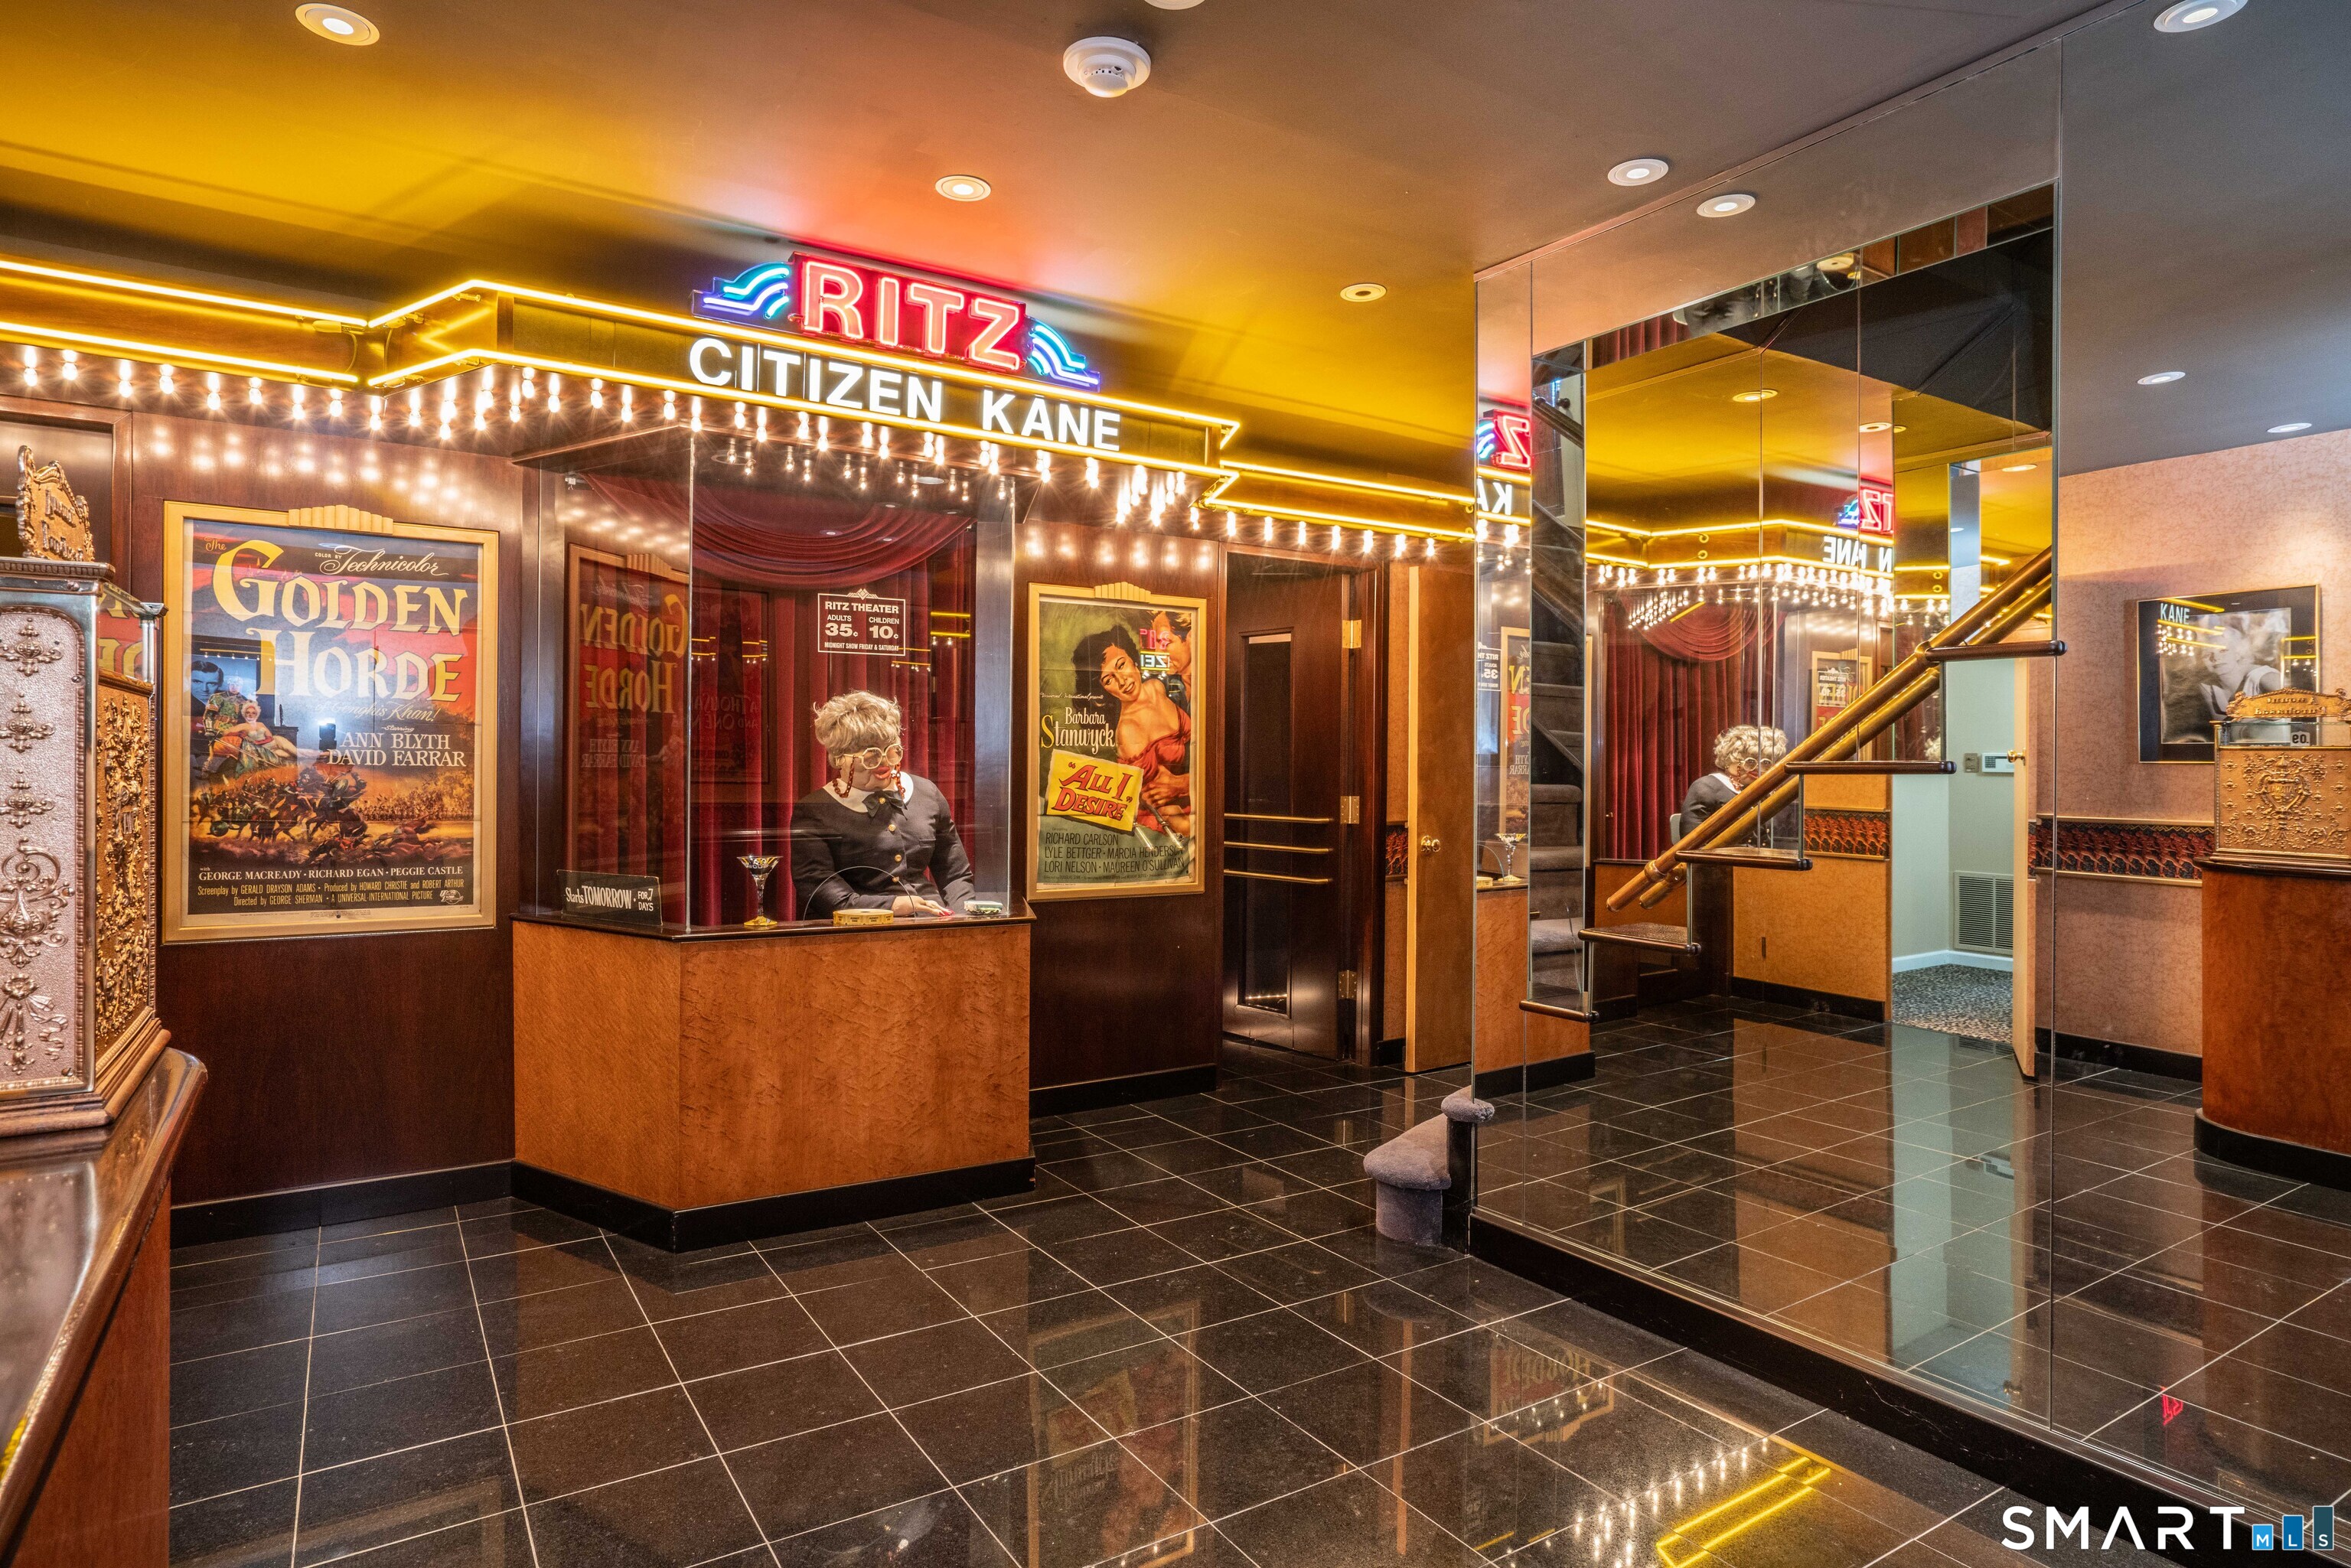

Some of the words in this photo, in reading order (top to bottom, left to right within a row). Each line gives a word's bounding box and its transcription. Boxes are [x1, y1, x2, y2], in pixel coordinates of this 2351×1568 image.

[802, 260, 1021, 371] RITZ
[690, 337, 943, 424] CITIZEN
[982, 389, 1121, 452] KANE
[204, 536, 227, 552] The
[318, 543, 450, 576] Technicolor
[213, 540, 468, 637] GOLDEN
[824, 601, 849, 611] RITZ
[851, 602, 899, 614] THEATER
[2160, 601, 2190, 625] KANE
[869, 616, 900, 624] CHILDREN
[246, 627, 463, 703] HORDE
[383, 701, 442, 722] Khan!
[1065, 706, 1107, 725] Barbara
[339, 732, 383, 748] ANN
[390, 733, 451, 750] BLYTH
[1041, 714, 1116, 755] Stanwyck
[327, 748, 386, 765] DAVID
[392, 750, 467, 767] FARRAR
[1045, 832, 1081, 845] RICHARD
[1083, 833, 1119, 846] CARLSON
[1045, 846, 1063, 859] LYLE
[1066, 846, 1102, 859] BETTGER
[1107, 847, 1136, 859] MARCIA
[1139, 845, 1184, 858] HENDERSON
[199, 871, 243, 881] GEORGE
[245, 870, 302, 880] MACREADY
[308, 869, 354, 879] RICHARD
[357, 868, 383, 878] EGAN
[390, 866, 426, 876] PEGGIE
[427, 865, 463, 875] CASTLE
[1044, 860, 1063, 872] LORI
[1065, 861, 1097, 873] NELSON
[1103, 861, 1140, 872] MAUREEN
[1142, 857, 1185, 872] O'SULLIVAN
[197, 885, 229, 896] Screenplay
[231, 886, 239, 896] by
[240, 885, 263, 895] GERALD
[266, 884, 292, 894] DRAYSON
[295, 883, 316, 893] ADAMS
[324, 882, 348, 893] Produced
[351, 883, 357, 892] by
[359, 882, 382, 891] HOWARD
[384, 881, 408, 890] CHRISTIE
[410, 881, 420, 889] and
[422, 879, 442, 889] ROBERT
[444, 879, 465, 888] ARTHUR
[637, 891, 648, 900] FOR
[647, 888, 654, 901] 7
[233, 896, 257, 906] Directed
[260, 897, 267, 906] by
[269, 895, 292, 905] GEORGE
[295, 894, 323, 904] SHERMAN
[331, 894, 335, 902] A
[412, 890, 433, 901] PICTURE
[565, 887, 584, 904] Starts
[582, 885, 632, 909] TOMORROW
[638, 901, 654, 911] DAYS
